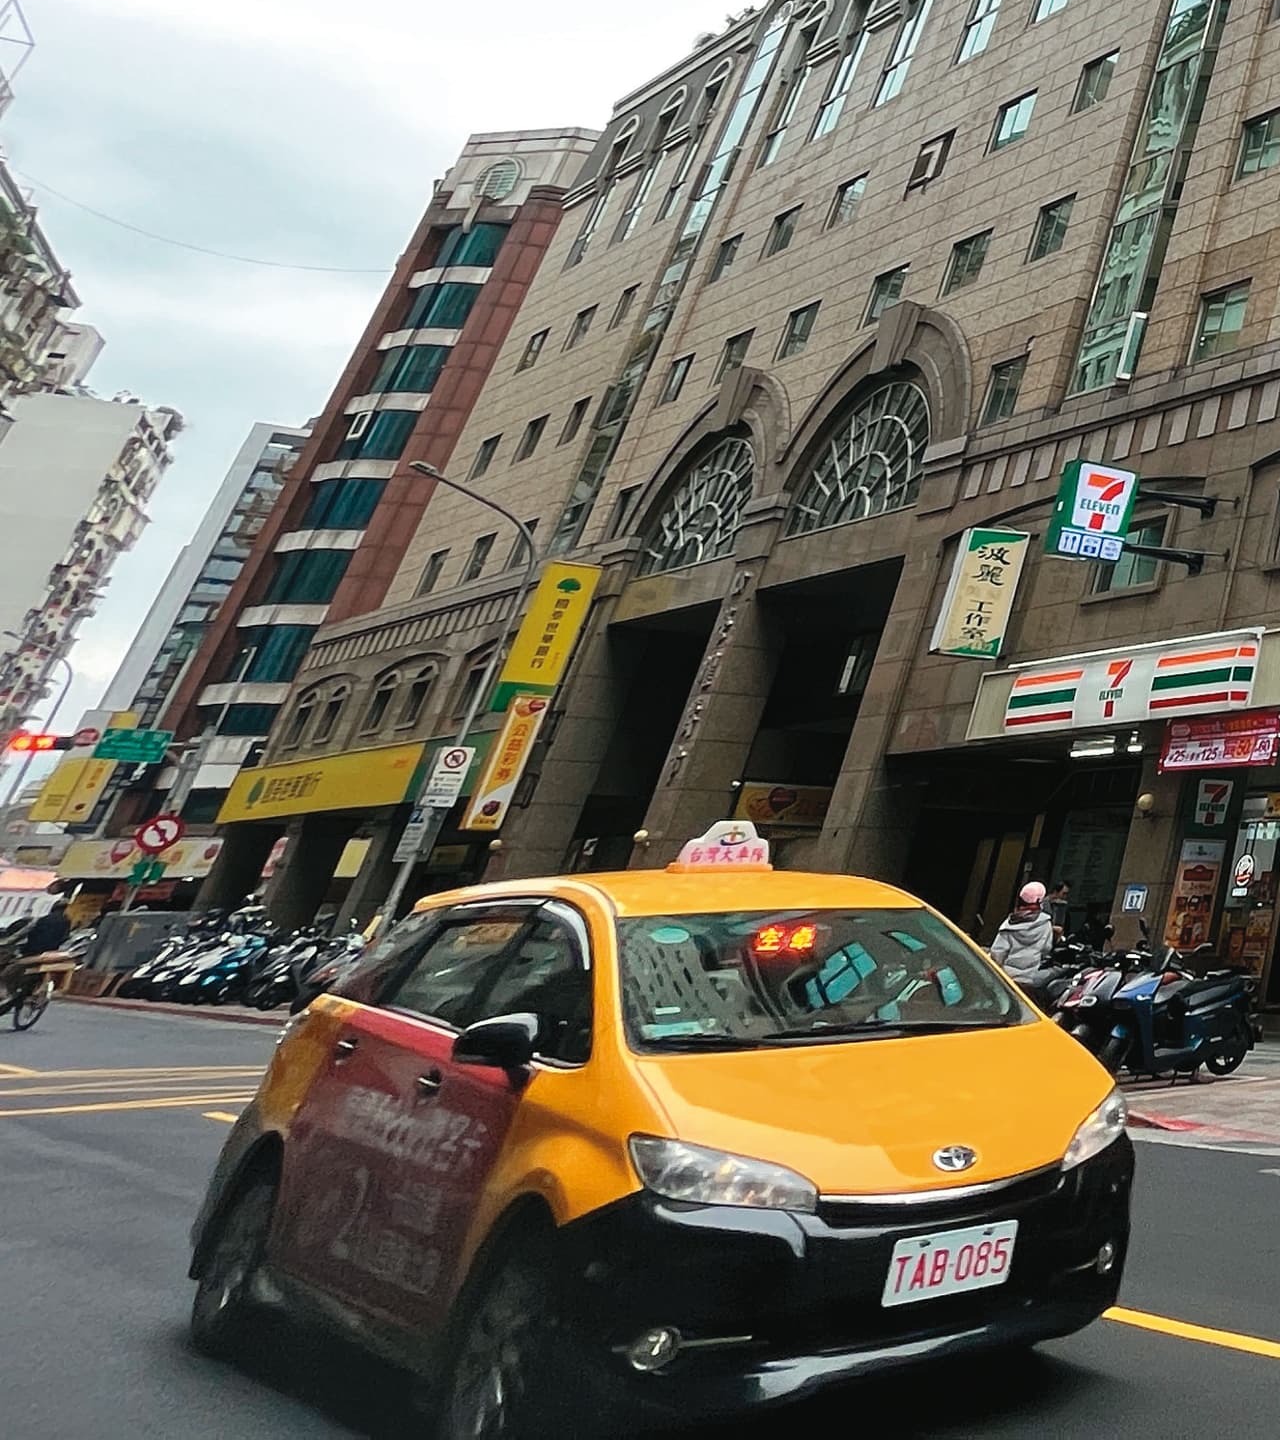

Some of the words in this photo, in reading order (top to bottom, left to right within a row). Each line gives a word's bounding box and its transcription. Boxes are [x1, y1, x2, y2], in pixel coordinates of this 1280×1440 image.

[1087, 472, 1126, 530] 7
[1106, 659, 1133, 718] 7
[690, 845, 765, 863] 台灣大車隊
[894, 1236, 1012, 1294] TAB-085
